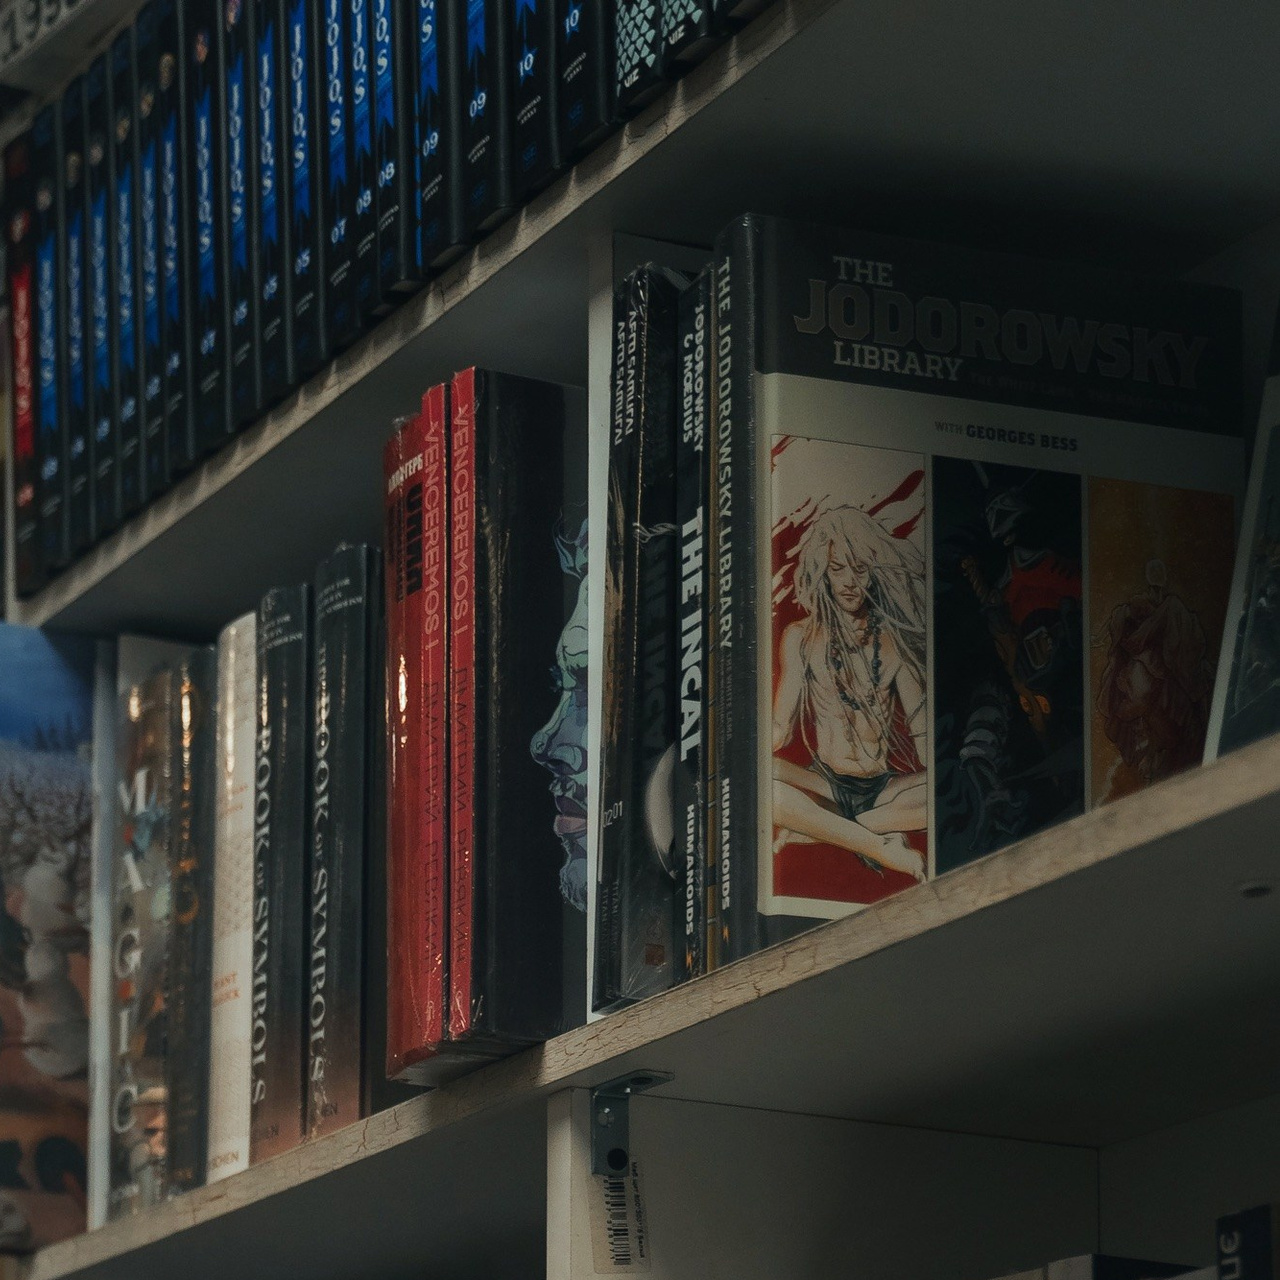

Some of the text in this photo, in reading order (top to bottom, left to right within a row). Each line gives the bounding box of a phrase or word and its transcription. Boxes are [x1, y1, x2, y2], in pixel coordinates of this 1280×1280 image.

[469, 92, 487, 118] 09
[519, 53, 534, 77] 10
[624, 67, 640, 88] VIZ
[422, 132, 440, 158] 09
[793, 278, 1210, 391] JODOROWSKY
[833, 255, 894, 289] THE
[692, 304, 706, 453] JODOROWSKY
[832, 340, 964, 382] LIBRARY
[718, 257, 734, 648] THE JODOROWSKY LIBRARY
[966, 423, 1037, 448] GEORGES
[1039, 432, 1079, 453] BESS
[423, 421, 441, 634] VENCEREMOS
[454, 404, 471, 620] VENCEREMOS
[678, 506, 704, 763] THE INCAL
[255, 725, 273, 852] BOOK
[314, 694, 331, 819] BOOK
[612, 800, 624, 819] 01
[684, 804, 696, 935] HUMANOIDS
[720, 778, 731, 910] HUMANOIDS
[250, 897, 270, 1104] SYMBOLS
[309, 868, 330, 1083] SYMBOLS
